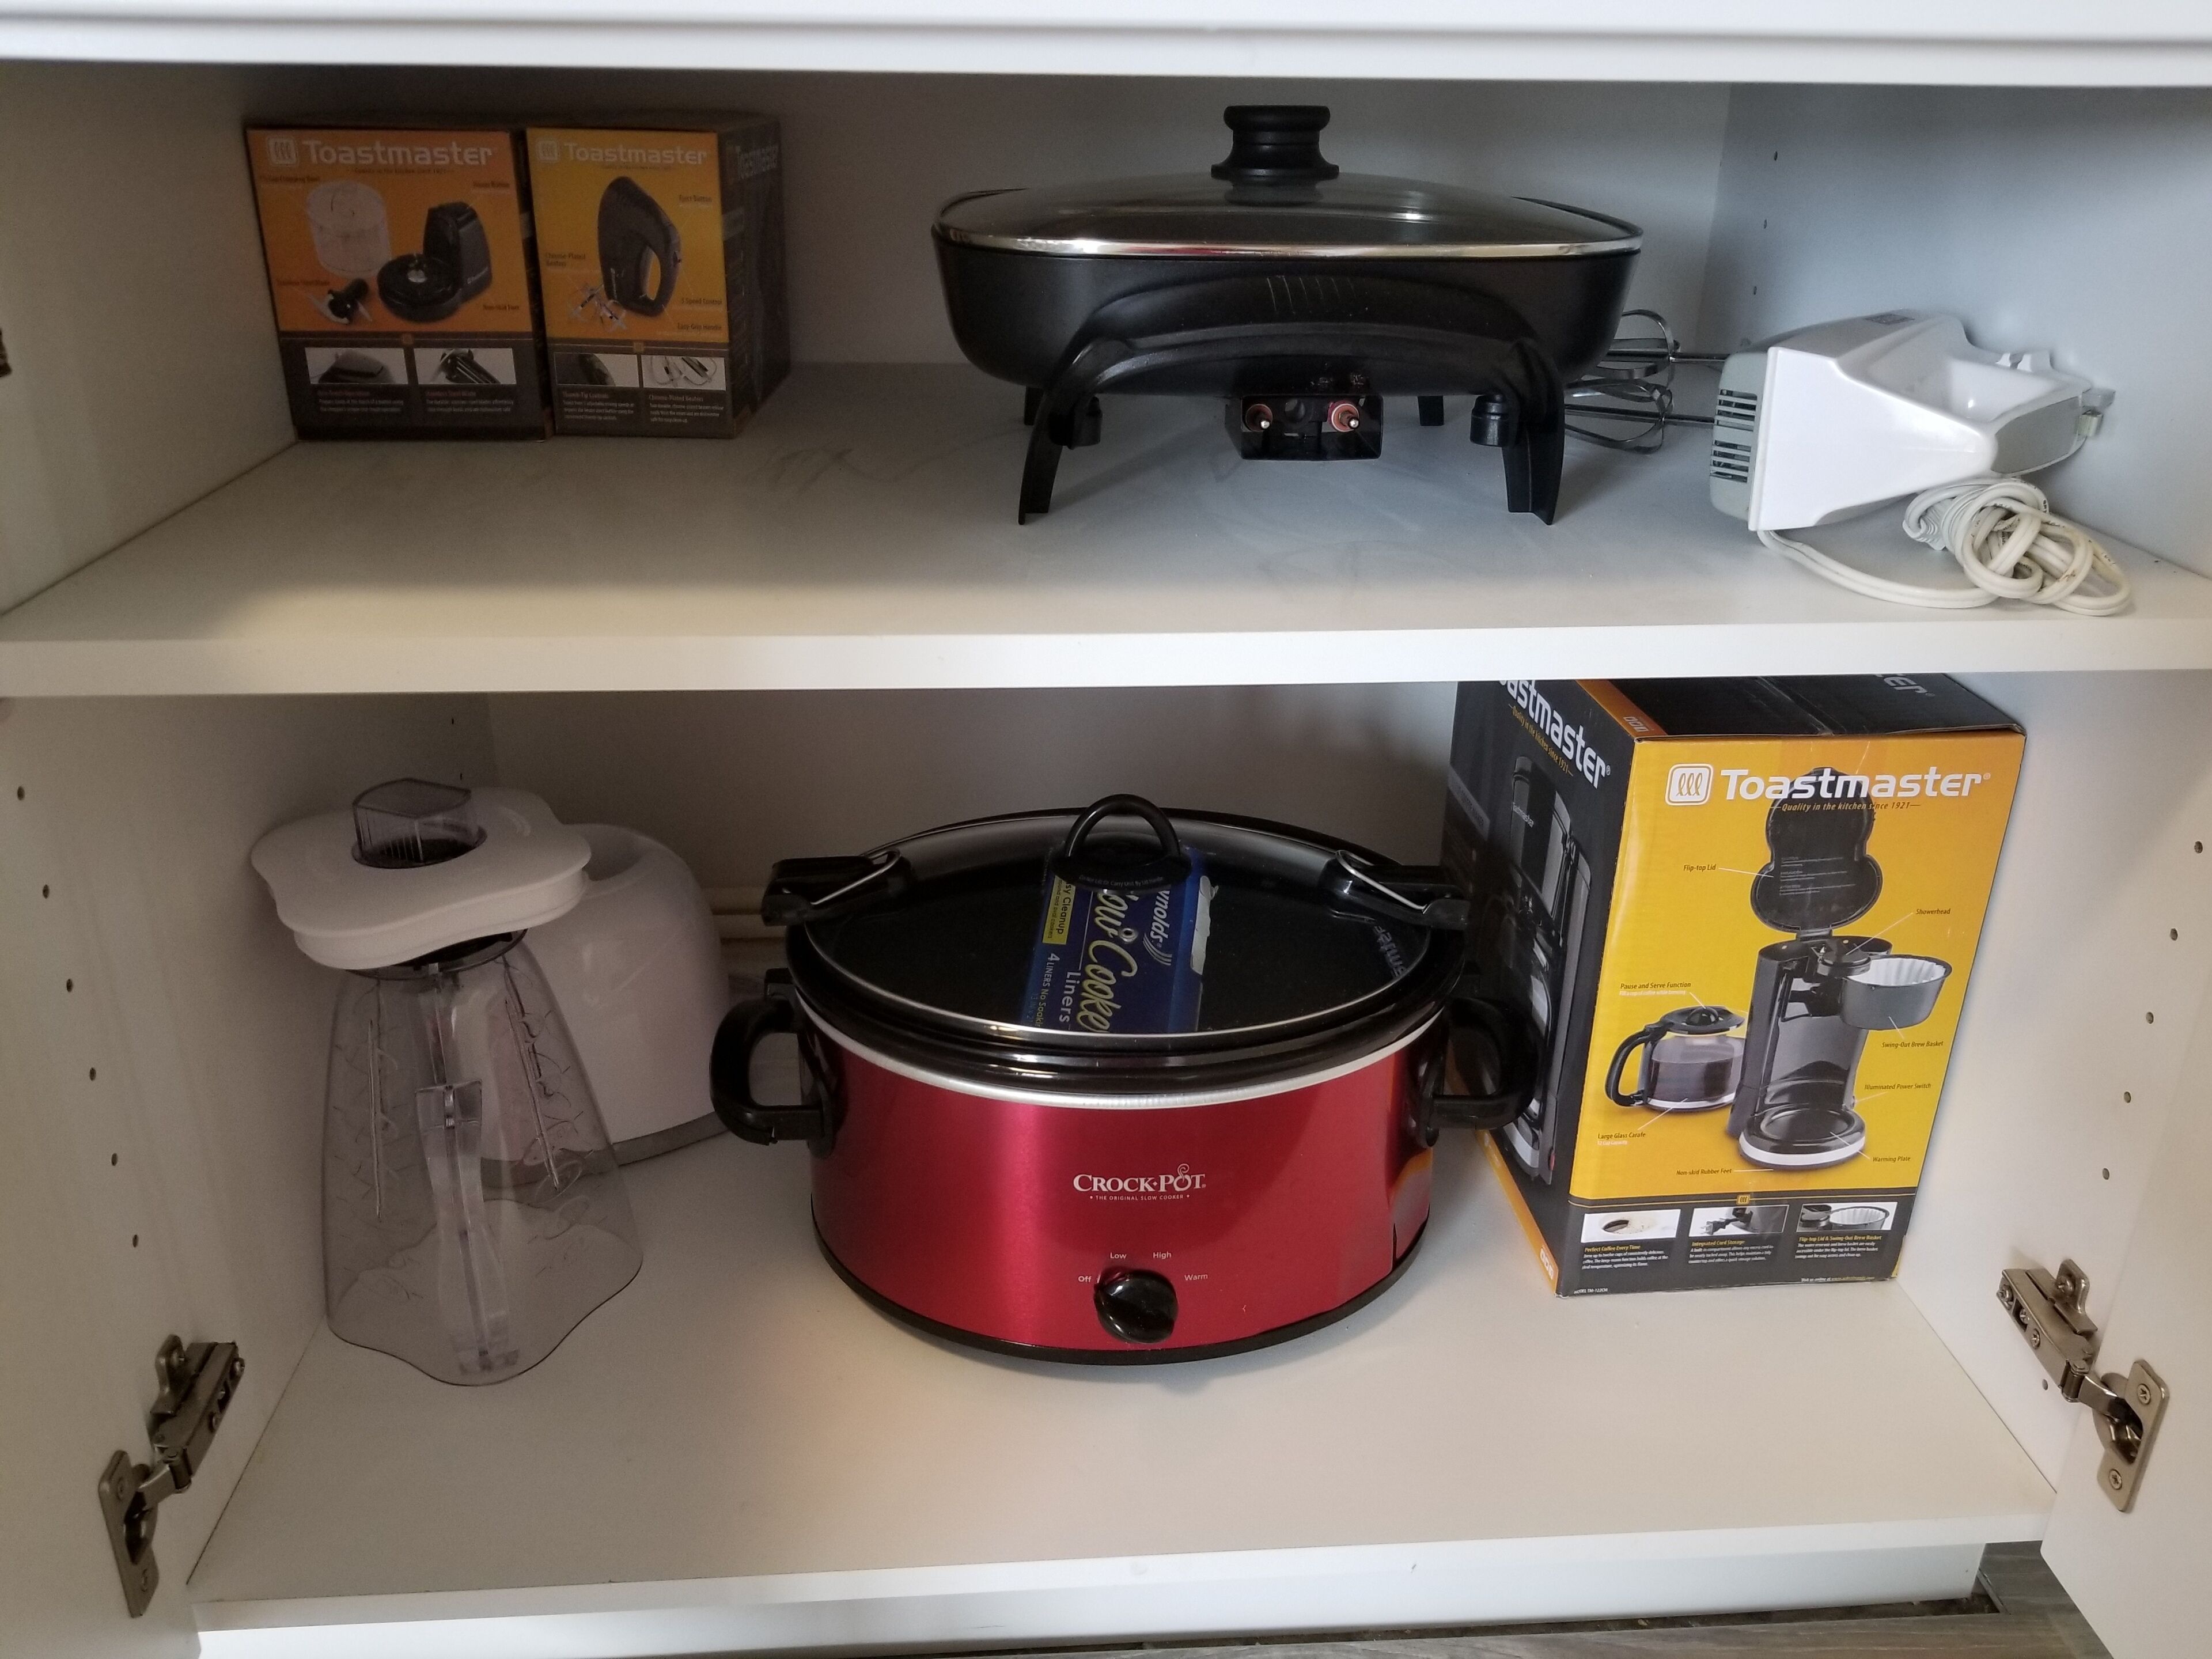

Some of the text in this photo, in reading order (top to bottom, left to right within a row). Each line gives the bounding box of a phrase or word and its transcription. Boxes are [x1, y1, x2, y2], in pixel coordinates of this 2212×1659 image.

[302, 141, 494, 166] Toastmaster
[564, 142, 707, 165] Toastmaster
[1721, 767, 1982, 800] Toastmaster
[1782, 803, 1810, 813] Quality
[1823, 802, 1835, 810] the
[1838, 801, 1866, 810] kitchen
[1868, 801, 1889, 809] since
[1891, 801, 1910, 809] 1921
[1056, 882, 1072, 935] sy Cleanup
[1047, 953, 1060, 961] 4
[1042, 962, 1055, 987] LINERS
[1040, 988, 1050, 1001] No
[1059, 971, 1081, 1023] Liners
[1153, 1251, 1172, 1260] High
